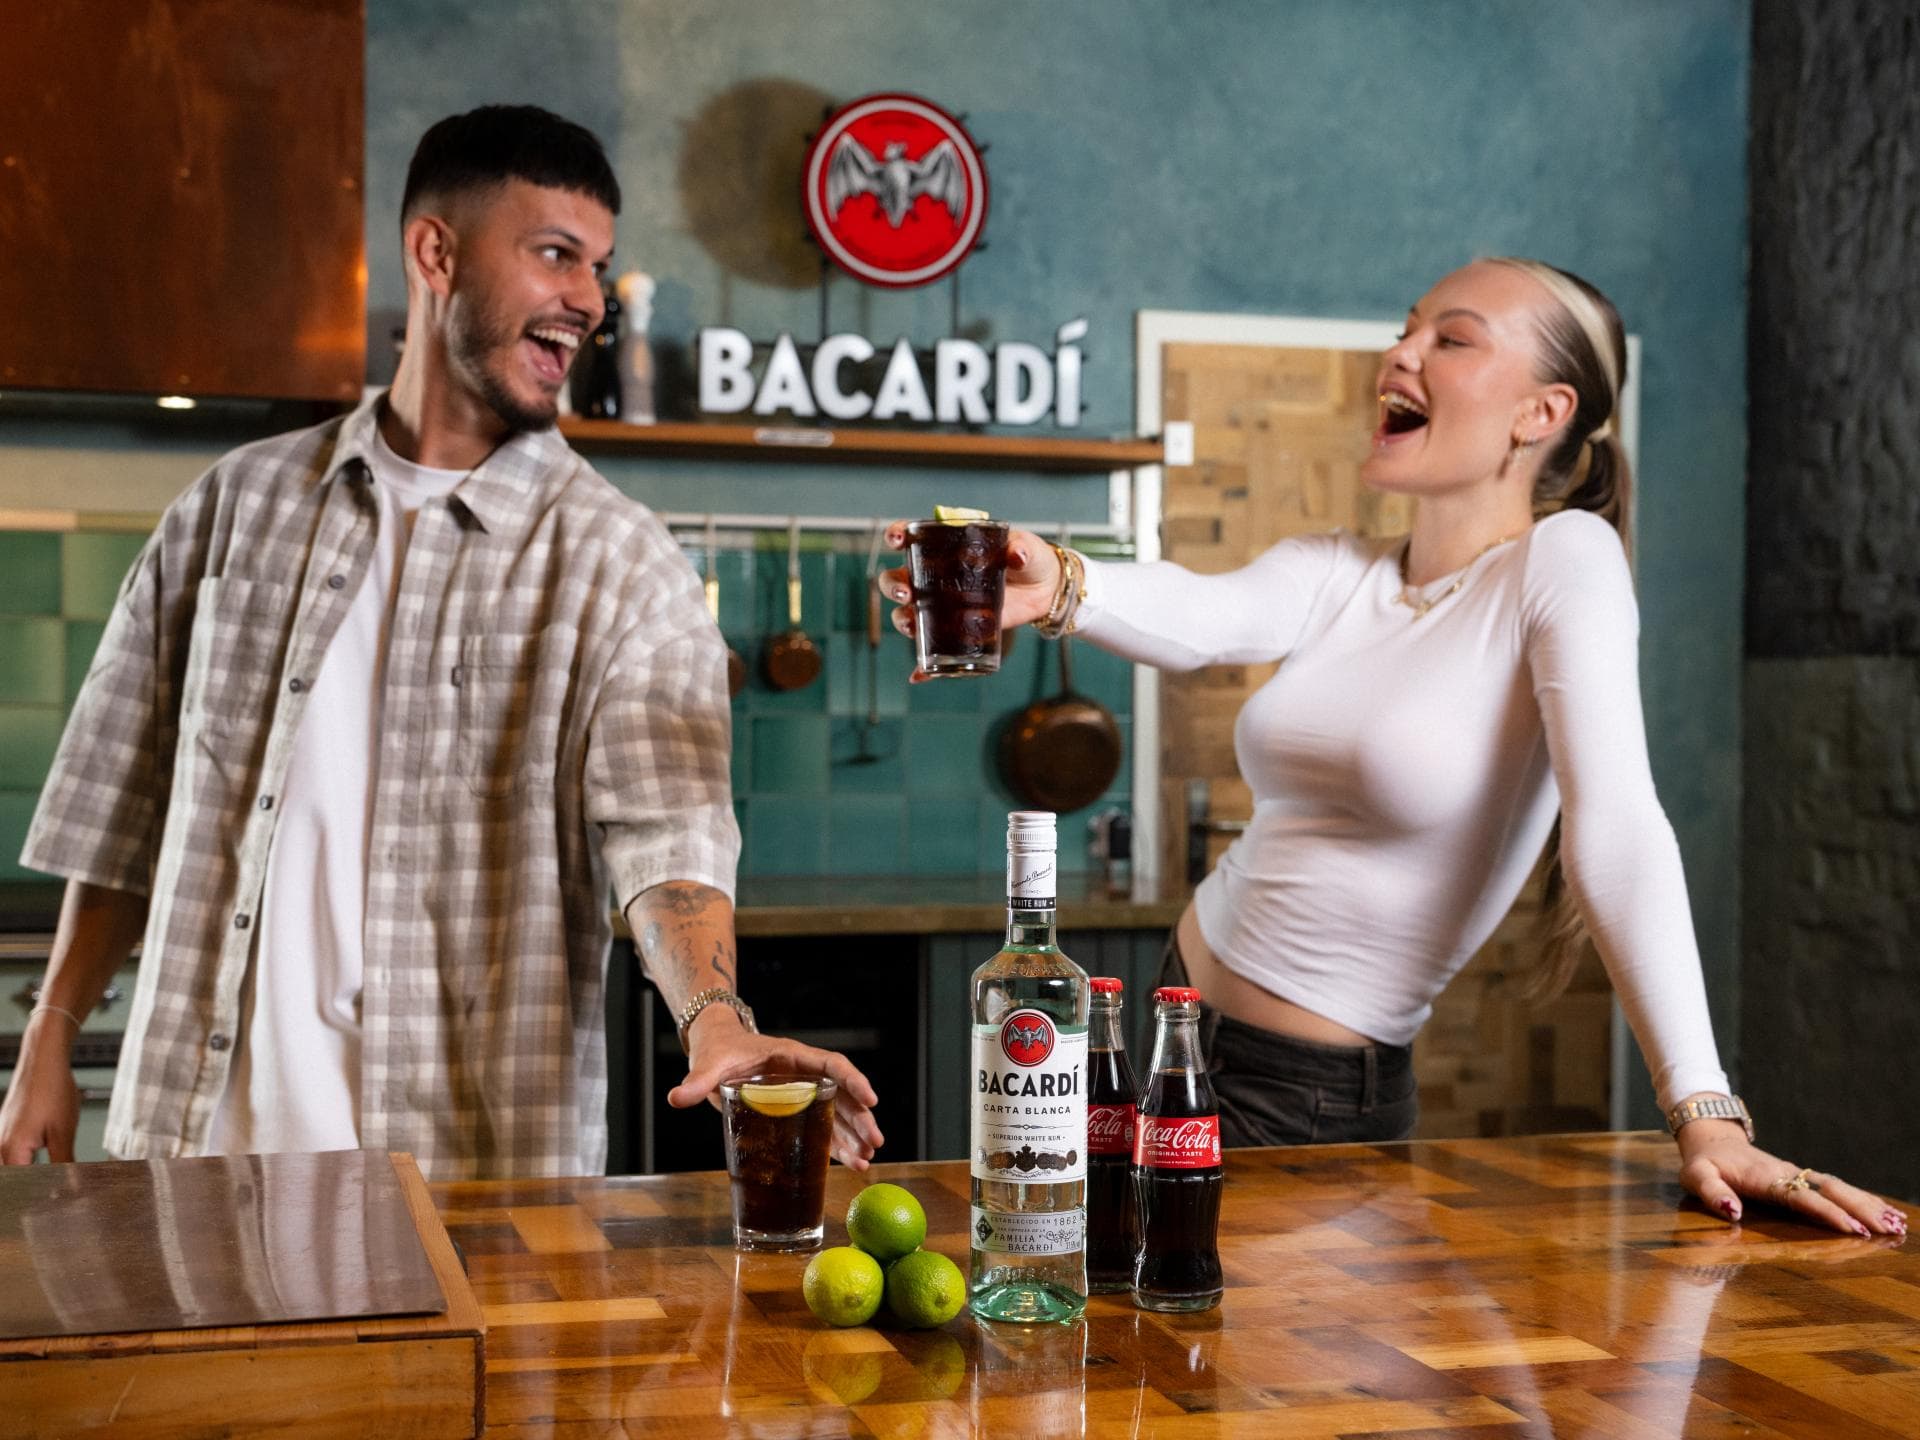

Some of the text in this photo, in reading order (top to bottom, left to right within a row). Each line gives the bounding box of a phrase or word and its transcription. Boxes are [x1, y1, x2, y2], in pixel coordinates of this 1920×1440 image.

[700, 318, 1088, 427] BACARDÍ
[978, 1064, 1079, 1097] BACARDÍ
[983, 1103, 1071, 1115] CARTA BLANCA
[992, 1133, 1023, 1142] SUPERIOR
[1053, 1215, 1077, 1226] 1862
[994, 1232, 1035, 1243] FAMILIA
